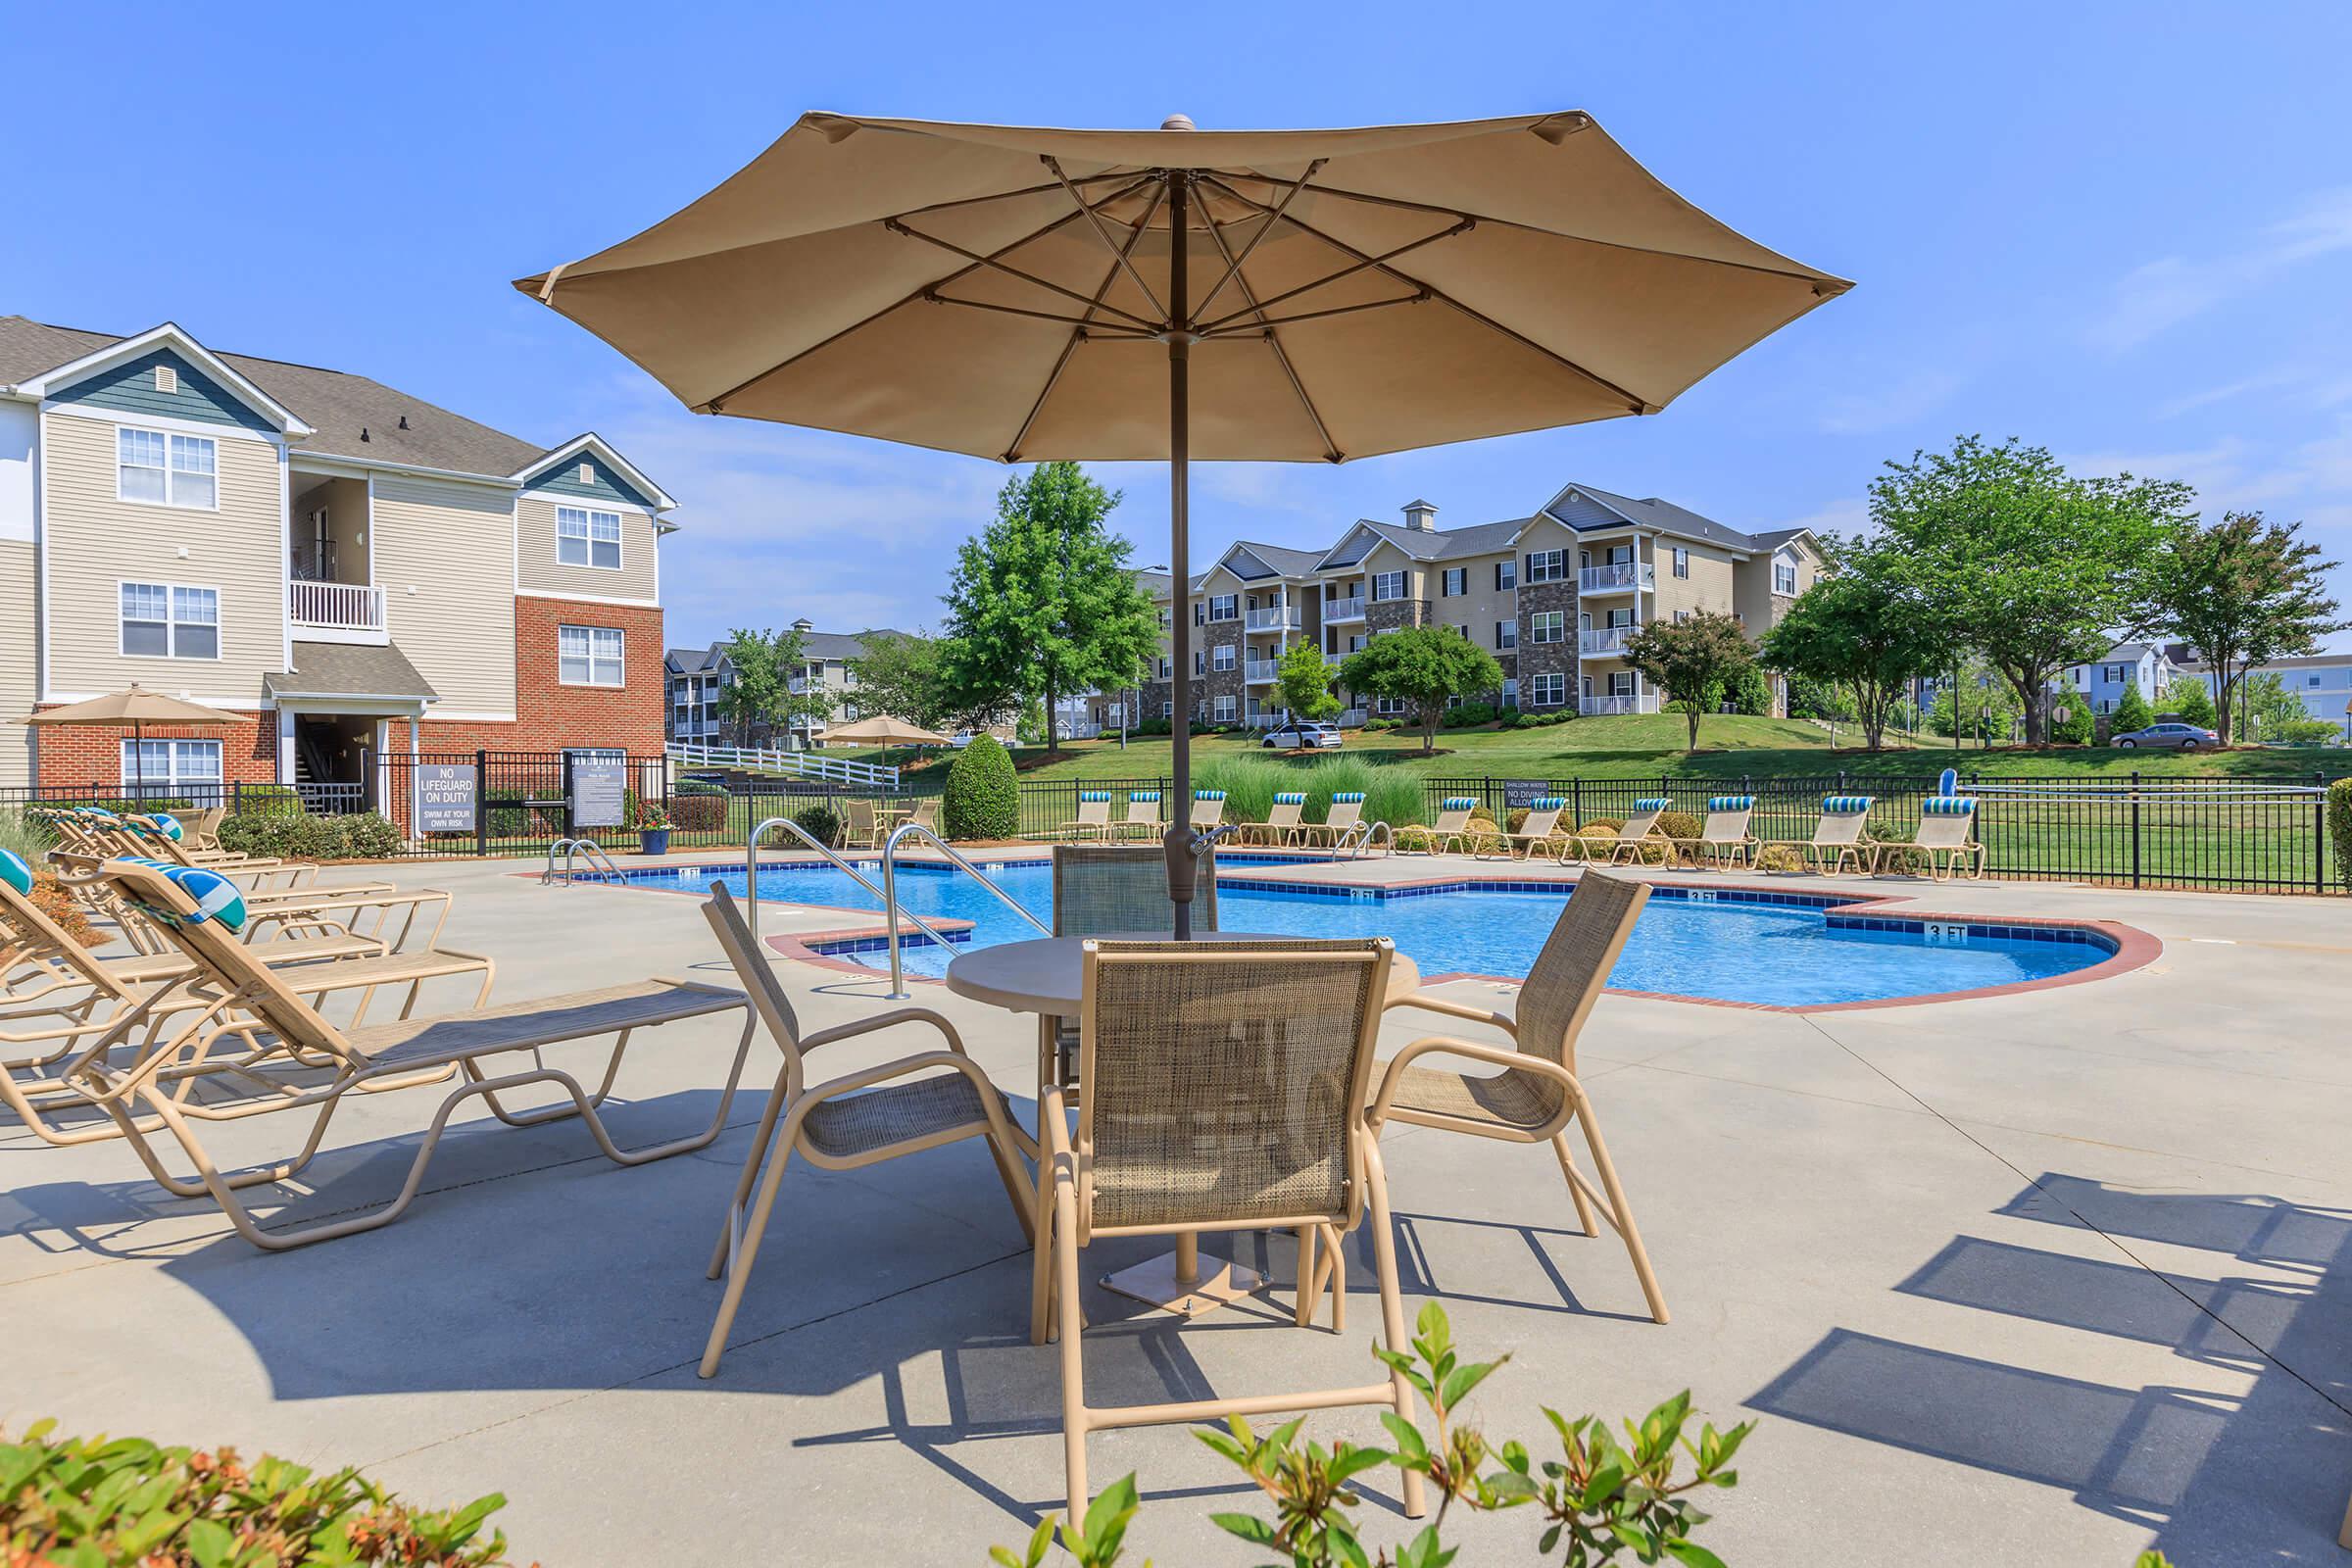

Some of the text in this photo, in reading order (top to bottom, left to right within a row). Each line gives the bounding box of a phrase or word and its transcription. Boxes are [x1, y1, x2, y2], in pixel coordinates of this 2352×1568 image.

[440, 768, 454, 778] NO
[420, 780, 472, 791] LIFEGUARD
[425, 792, 467, 803] ON DUTY
[1703, 892, 1715, 902] FT
[1931, 925, 1966, 941] 3 FT
